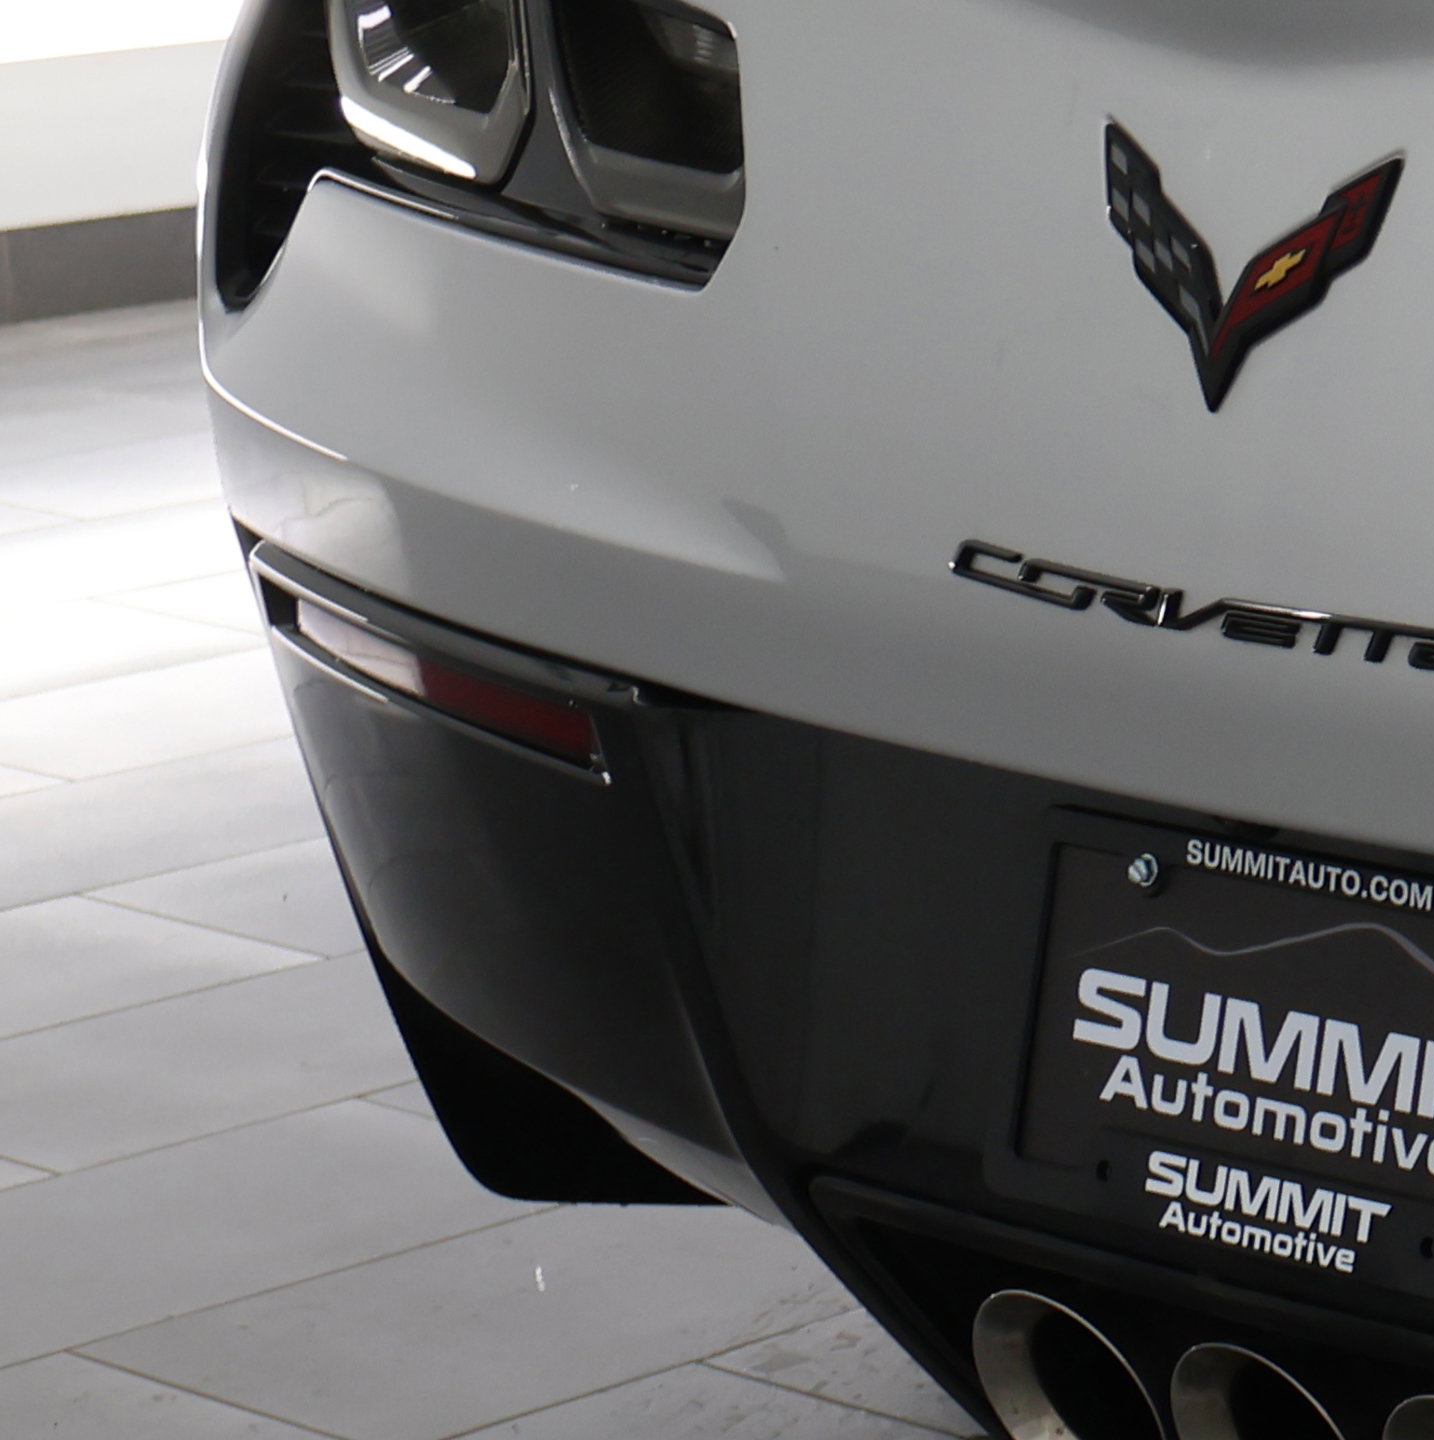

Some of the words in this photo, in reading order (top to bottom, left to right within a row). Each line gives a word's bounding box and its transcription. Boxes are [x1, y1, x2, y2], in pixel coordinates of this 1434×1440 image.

[1186, 839, 1434, 911] SUMMITAUTO.COM
[1144, 1150, 1392, 1244] SUMMIT
[1158, 1201, 1356, 1274] Automotive
